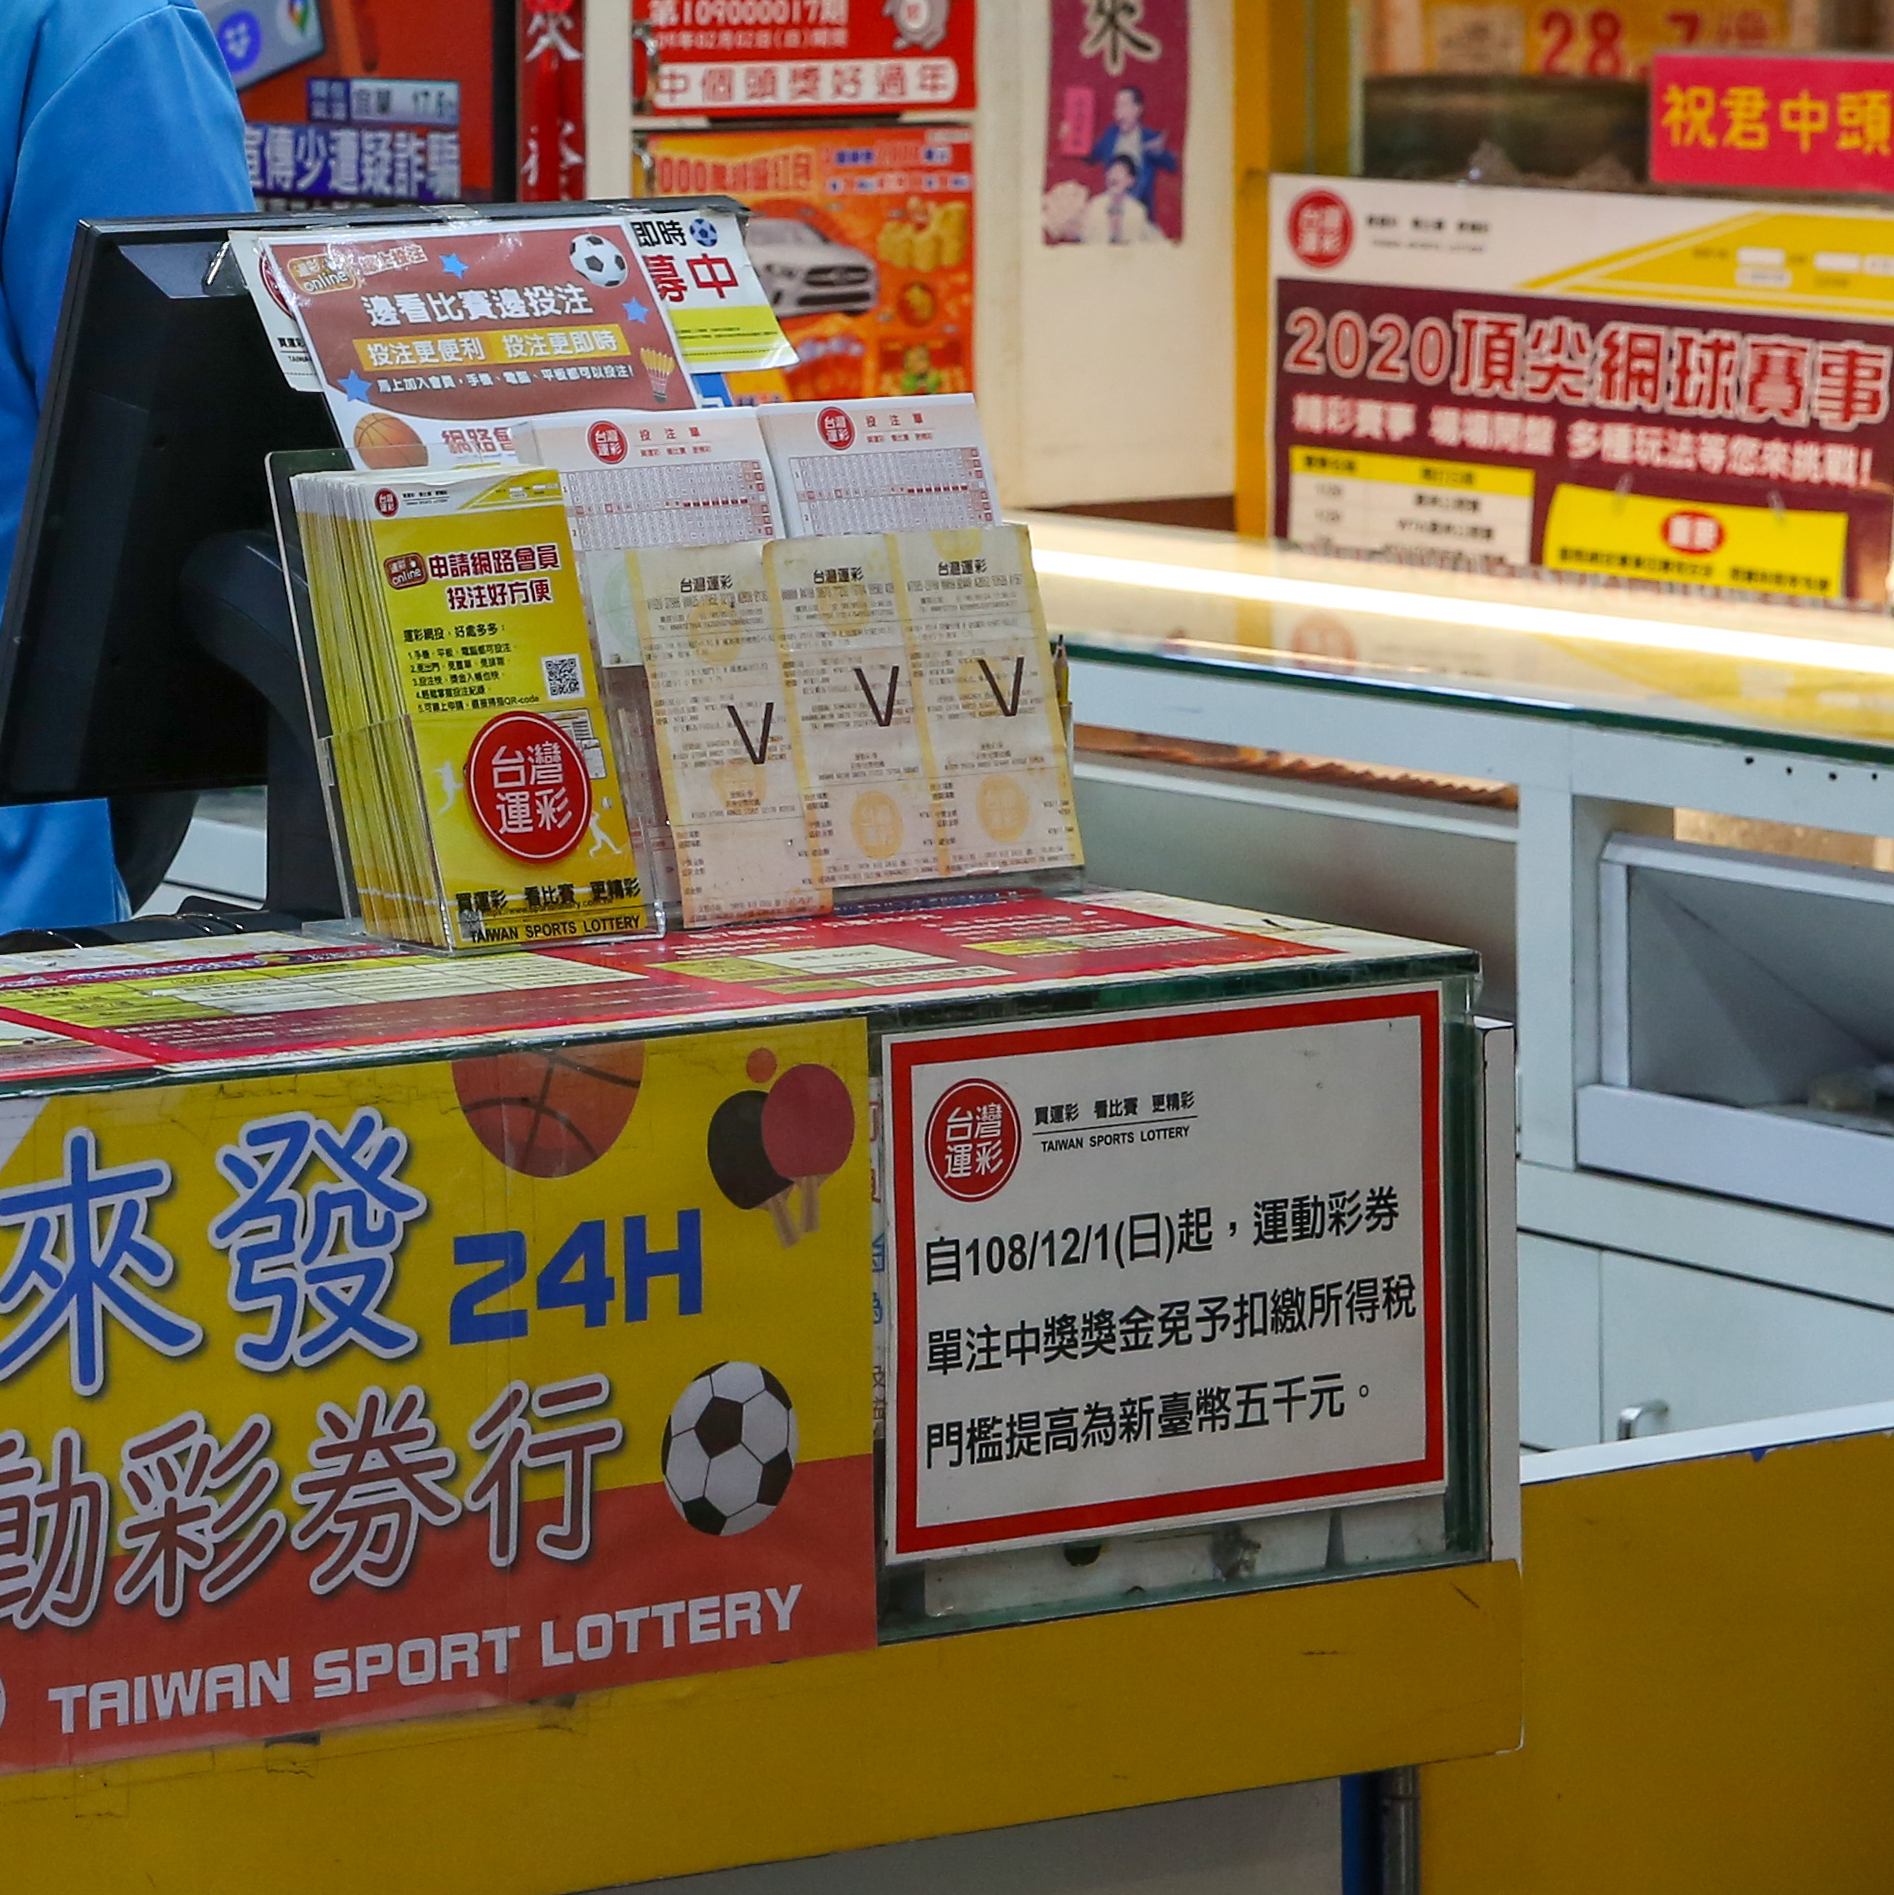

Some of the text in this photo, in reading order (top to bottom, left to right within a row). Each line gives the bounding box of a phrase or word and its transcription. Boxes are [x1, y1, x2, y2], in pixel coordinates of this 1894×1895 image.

[658, 63, 949, 103] 中個頭獎好過年
[1663, 84, 1894, 158] 祝君中頭
[635, 220, 687, 248] 即時
[360, 283, 595, 329] 邊看比賽邊投注
[365, 331, 618, 368] 投注更便利 投注更即時
[1284, 307, 1891, 433] 2020頂尖網球賽事
[639, 426, 701, 443] 投注單
[428, 544, 560, 580] 申請網路會員
[813, 566, 865, 585] 台灣運彩
[446, 580, 552, 611] 投注好方便
[680, 576, 734, 594] 台灣運彩
[492, 741, 564, 789] 台灣
[495, 786, 573, 835] 運彩
[471, 914, 641, 944] TAIWAN SPORTS LOTTERY
[945, 1101, 1005, 1143] 台灣
[1033, 1089, 1196, 1127] 買運彩 看比賽 更精彩
[1040, 1124, 1190, 1154] TAIWAN SPORTS LOTTERY
[943, 1141, 1005, 1181] 運彩
[924, 1186, 1400, 1286] 自108/12/1(日)起，運動彩券
[448, 1208, 704, 1348] 24H
[926, 1274, 1416, 1377] 單注中獎獎金免予扣繳所得稅
[924, 1372, 1371, 1471] 門檻提高為新臺幣五千元。
[48, 1583, 804, 1736] TAIWAN SPORT LOTTERY
